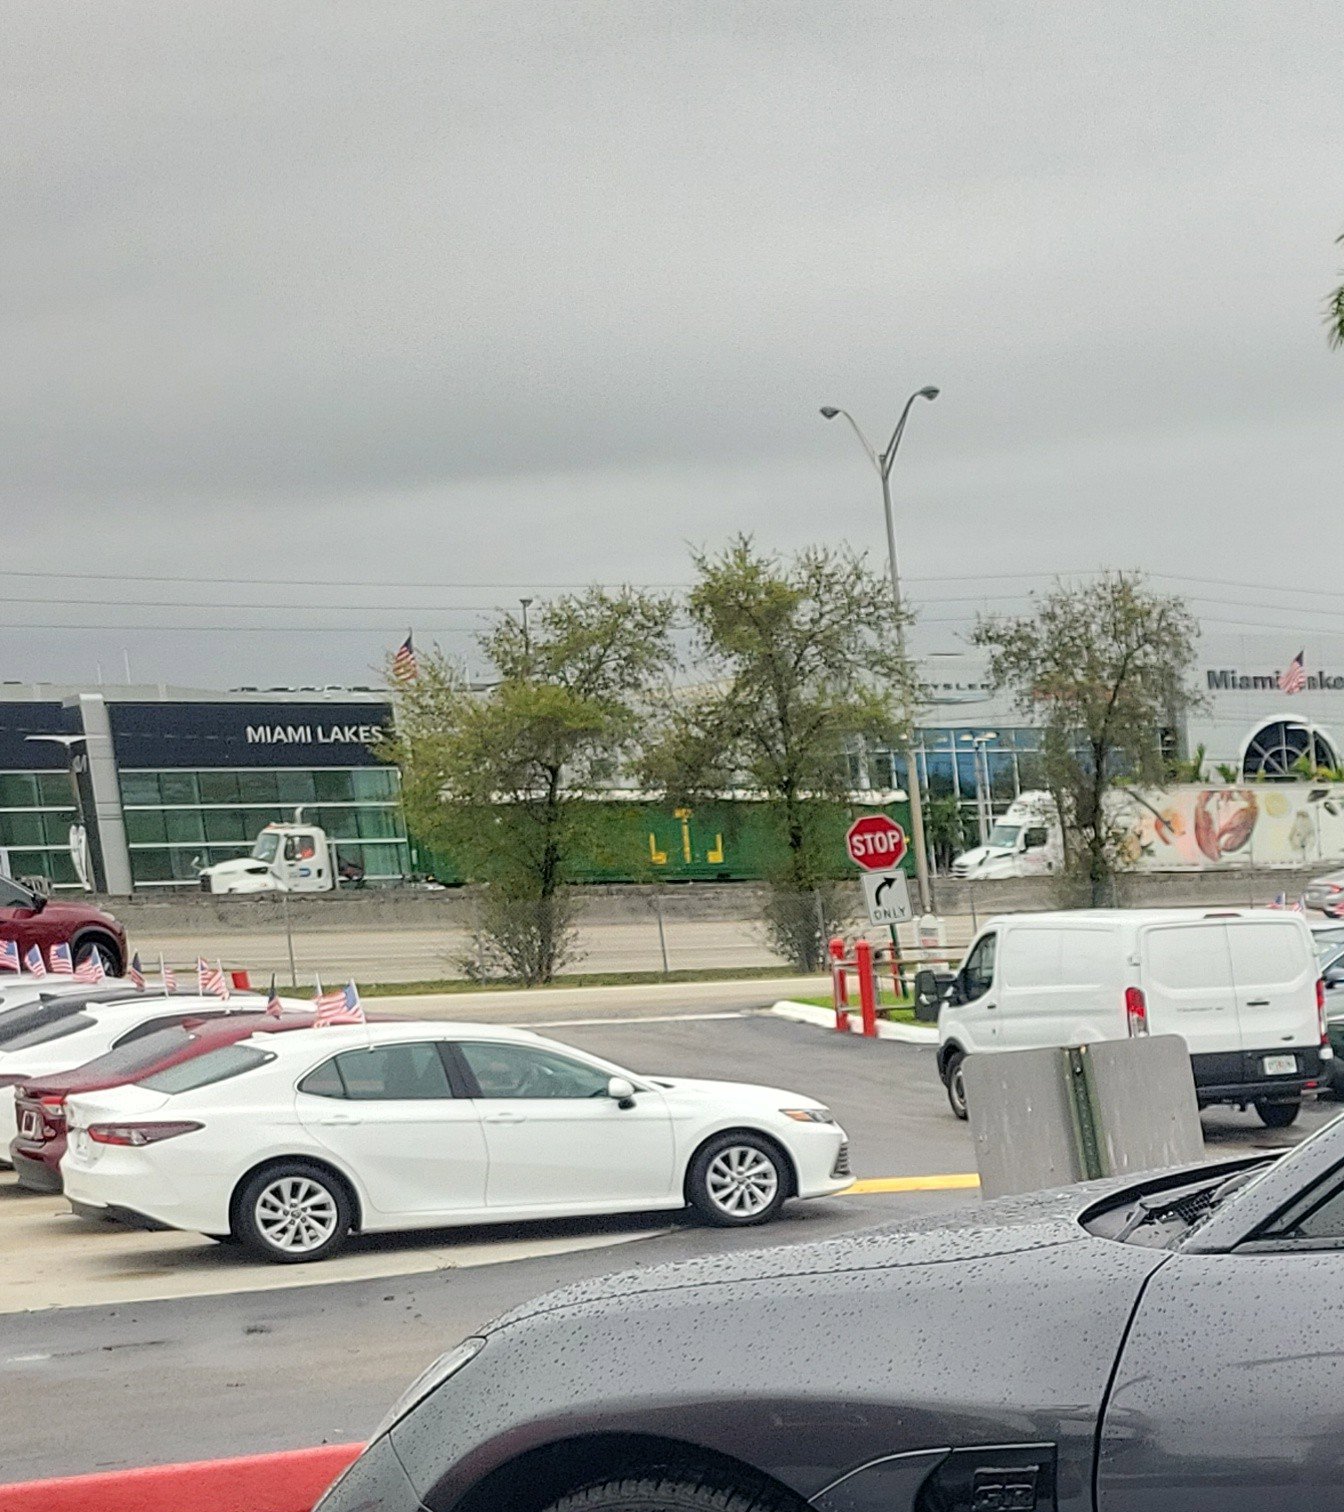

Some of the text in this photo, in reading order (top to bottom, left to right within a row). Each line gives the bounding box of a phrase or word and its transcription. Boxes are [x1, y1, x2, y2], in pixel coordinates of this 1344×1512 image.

[1206, 669, 1281, 690] Miami
[246, 725, 383, 743] MIAMI LAKES
[851, 829, 900, 857] STOP
[873, 906, 907, 920] ONLY
